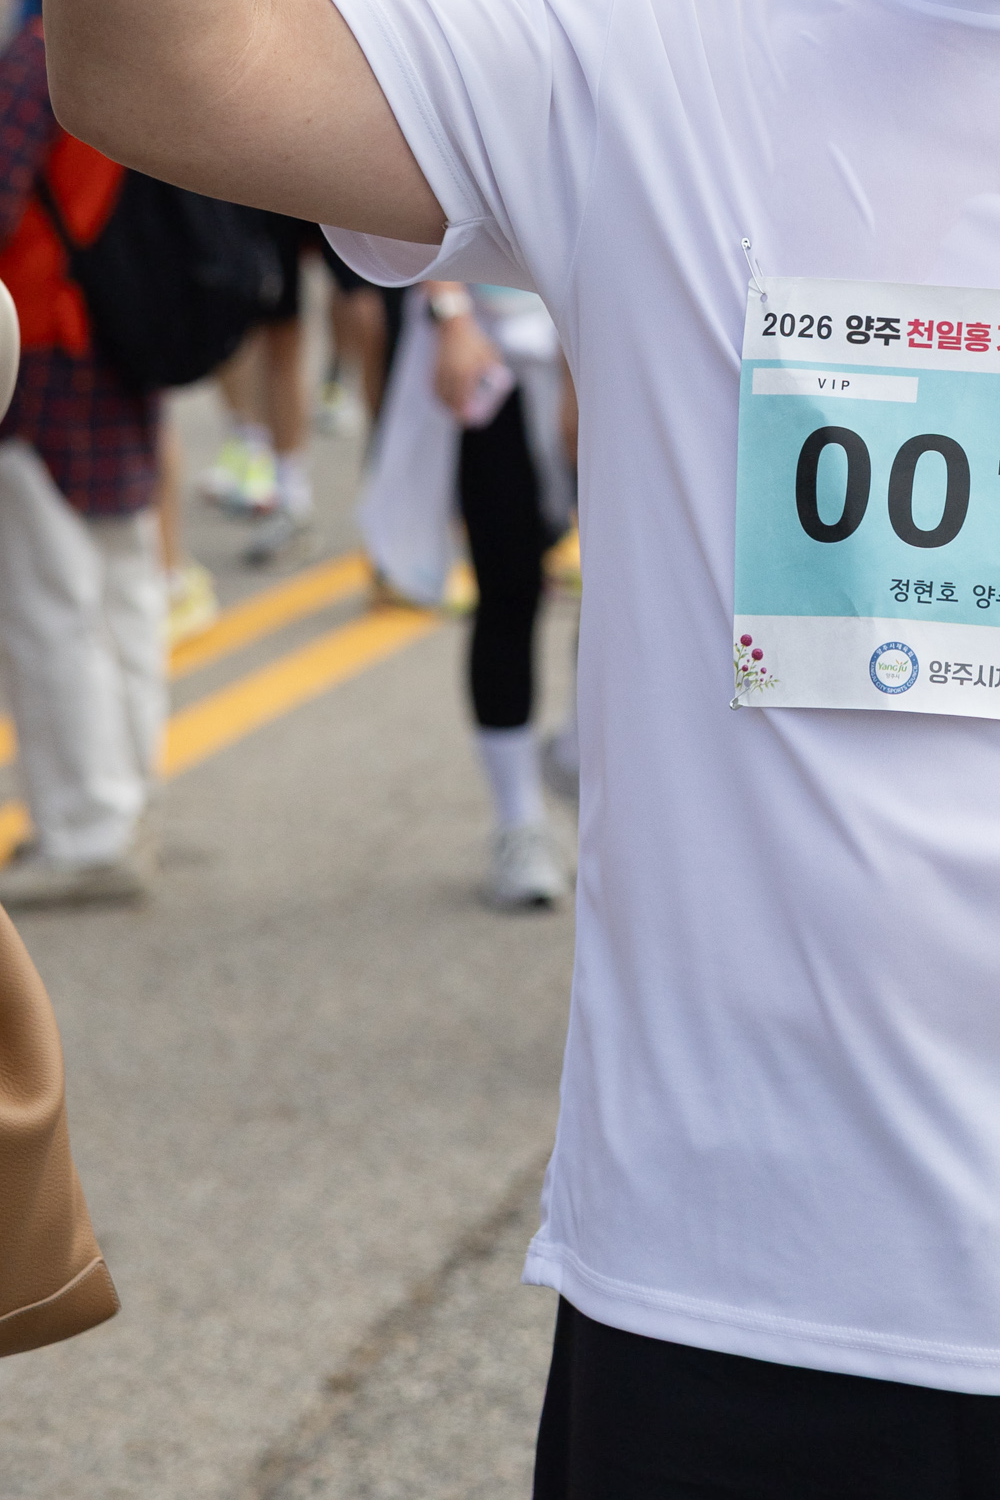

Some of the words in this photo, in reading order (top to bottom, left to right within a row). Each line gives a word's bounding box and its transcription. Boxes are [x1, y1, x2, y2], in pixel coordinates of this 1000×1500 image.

[762, 312, 833, 340] 2026
[845, 314, 901, 347] 양주
[906, 318, 992, 353] 천일홍
[817, 377, 851, 391] VIP
[889, 578, 959, 605] 정현호
